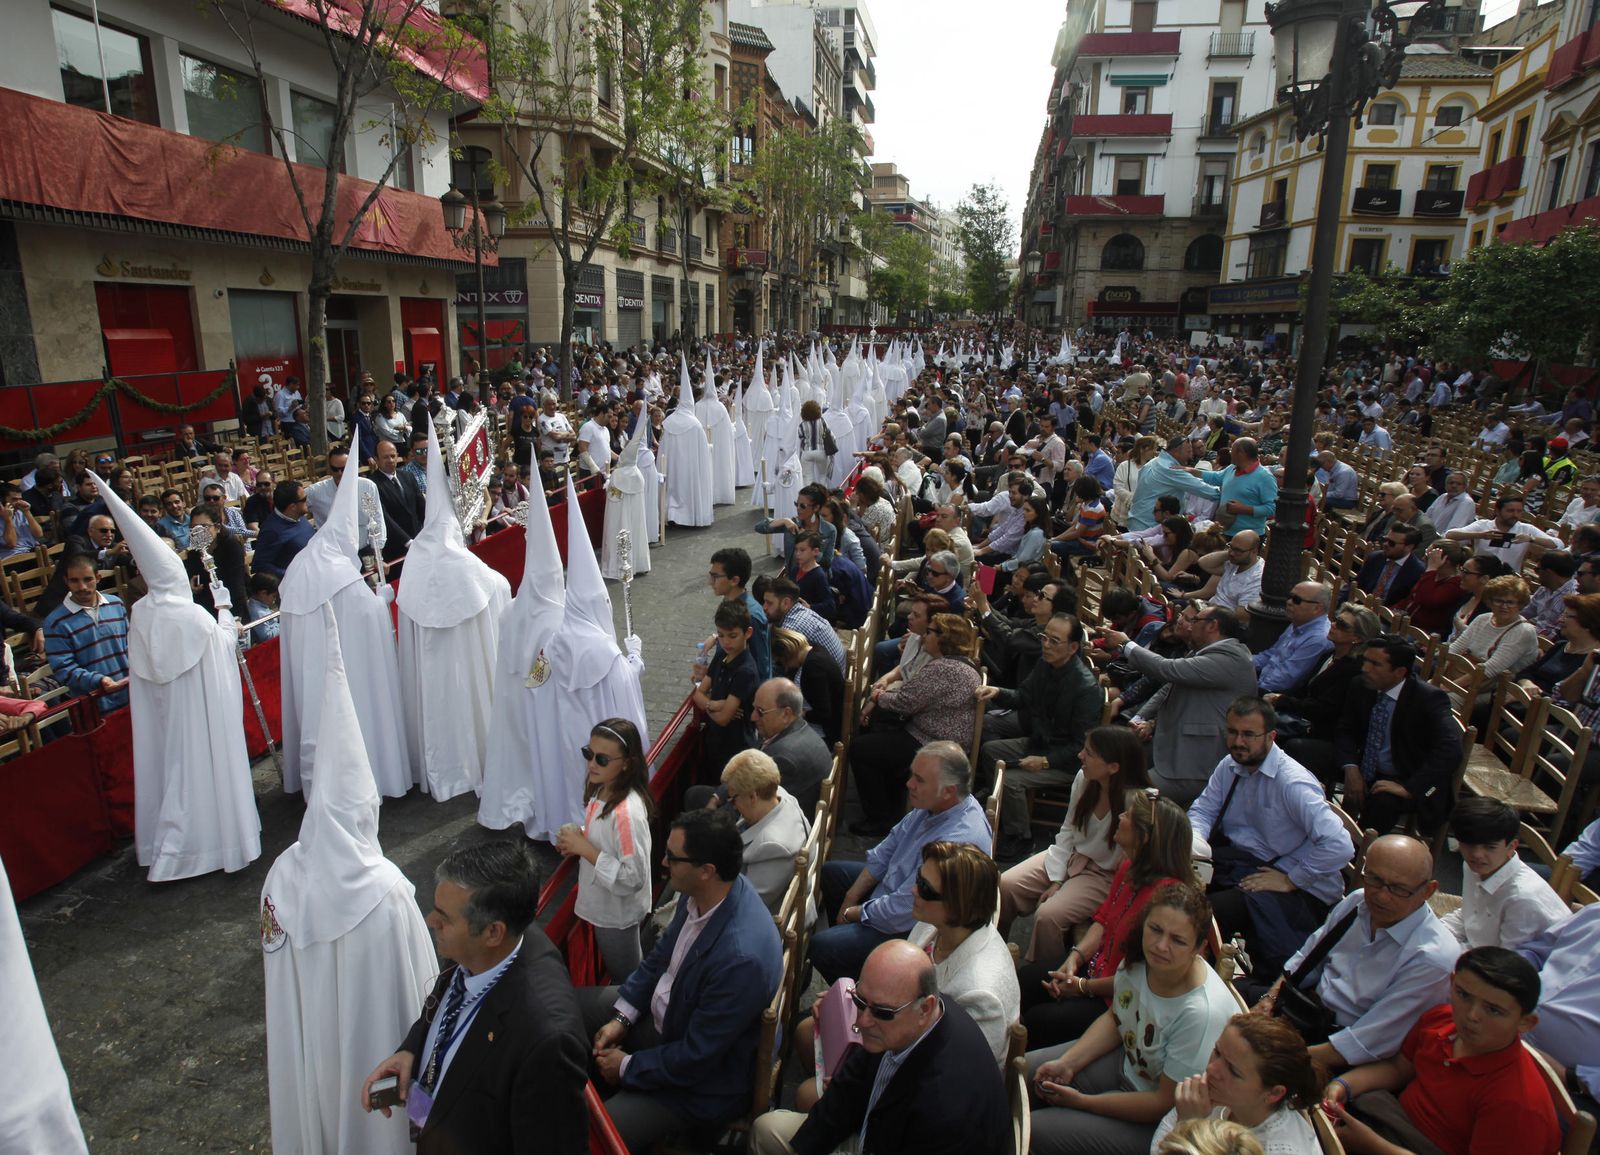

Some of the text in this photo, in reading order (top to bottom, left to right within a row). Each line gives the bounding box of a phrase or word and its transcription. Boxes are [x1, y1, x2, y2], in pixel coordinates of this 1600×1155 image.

[120, 260, 191, 281] Santander
[342, 277, 382, 292] Santander
[574, 293, 601, 305] DENTIX
[624, 298, 644, 307] DENTIX
